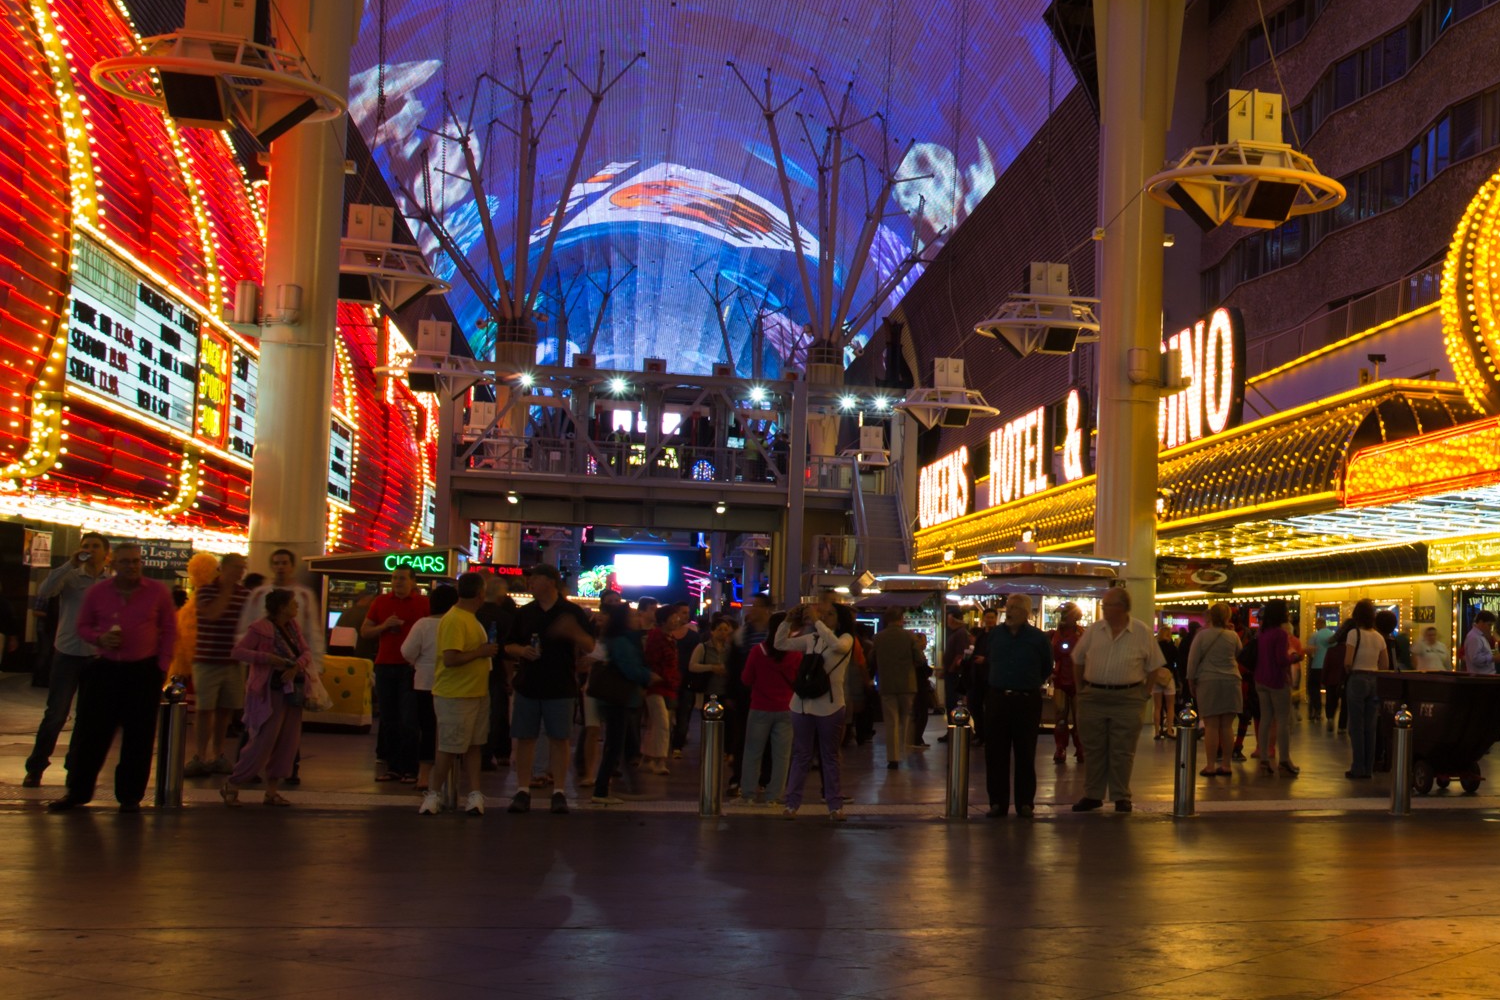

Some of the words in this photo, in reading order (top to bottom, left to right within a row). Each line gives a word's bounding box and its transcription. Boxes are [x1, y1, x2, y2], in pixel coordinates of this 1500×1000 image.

[918, 444, 969, 529] QUEENS
[988, 405, 1048, 508] HOTEL
[1063, 389, 1084, 482] &
[1157, 307, 1234, 450] INO
[150, 546, 178, 559] Legs
[179, 549, 189, 558] &
[141, 556, 168, 569] imp
[384, 554, 446, 573] CIGARS
